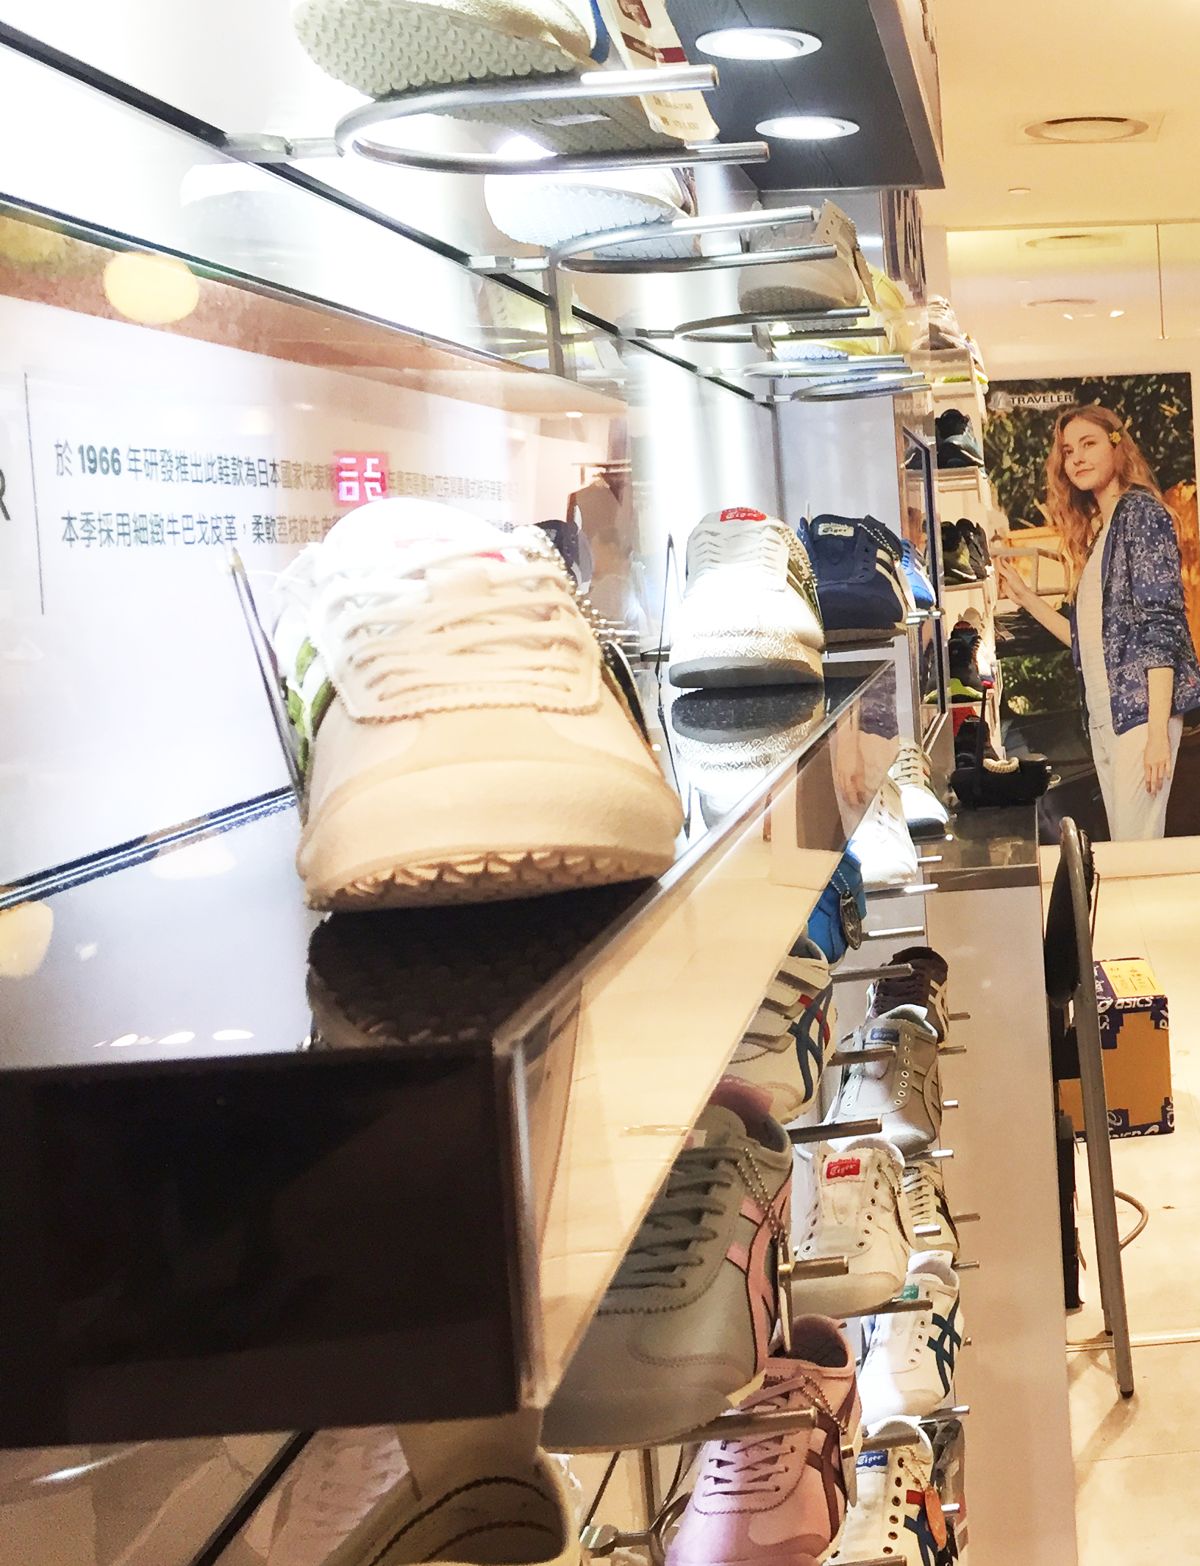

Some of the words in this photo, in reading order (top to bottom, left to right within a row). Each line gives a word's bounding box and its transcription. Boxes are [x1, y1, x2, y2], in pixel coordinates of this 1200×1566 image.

[1010, 394, 1073, 405] TRAVELER
[54, 438, 72, 476] 於
[78, 444, 122, 475] 1966
